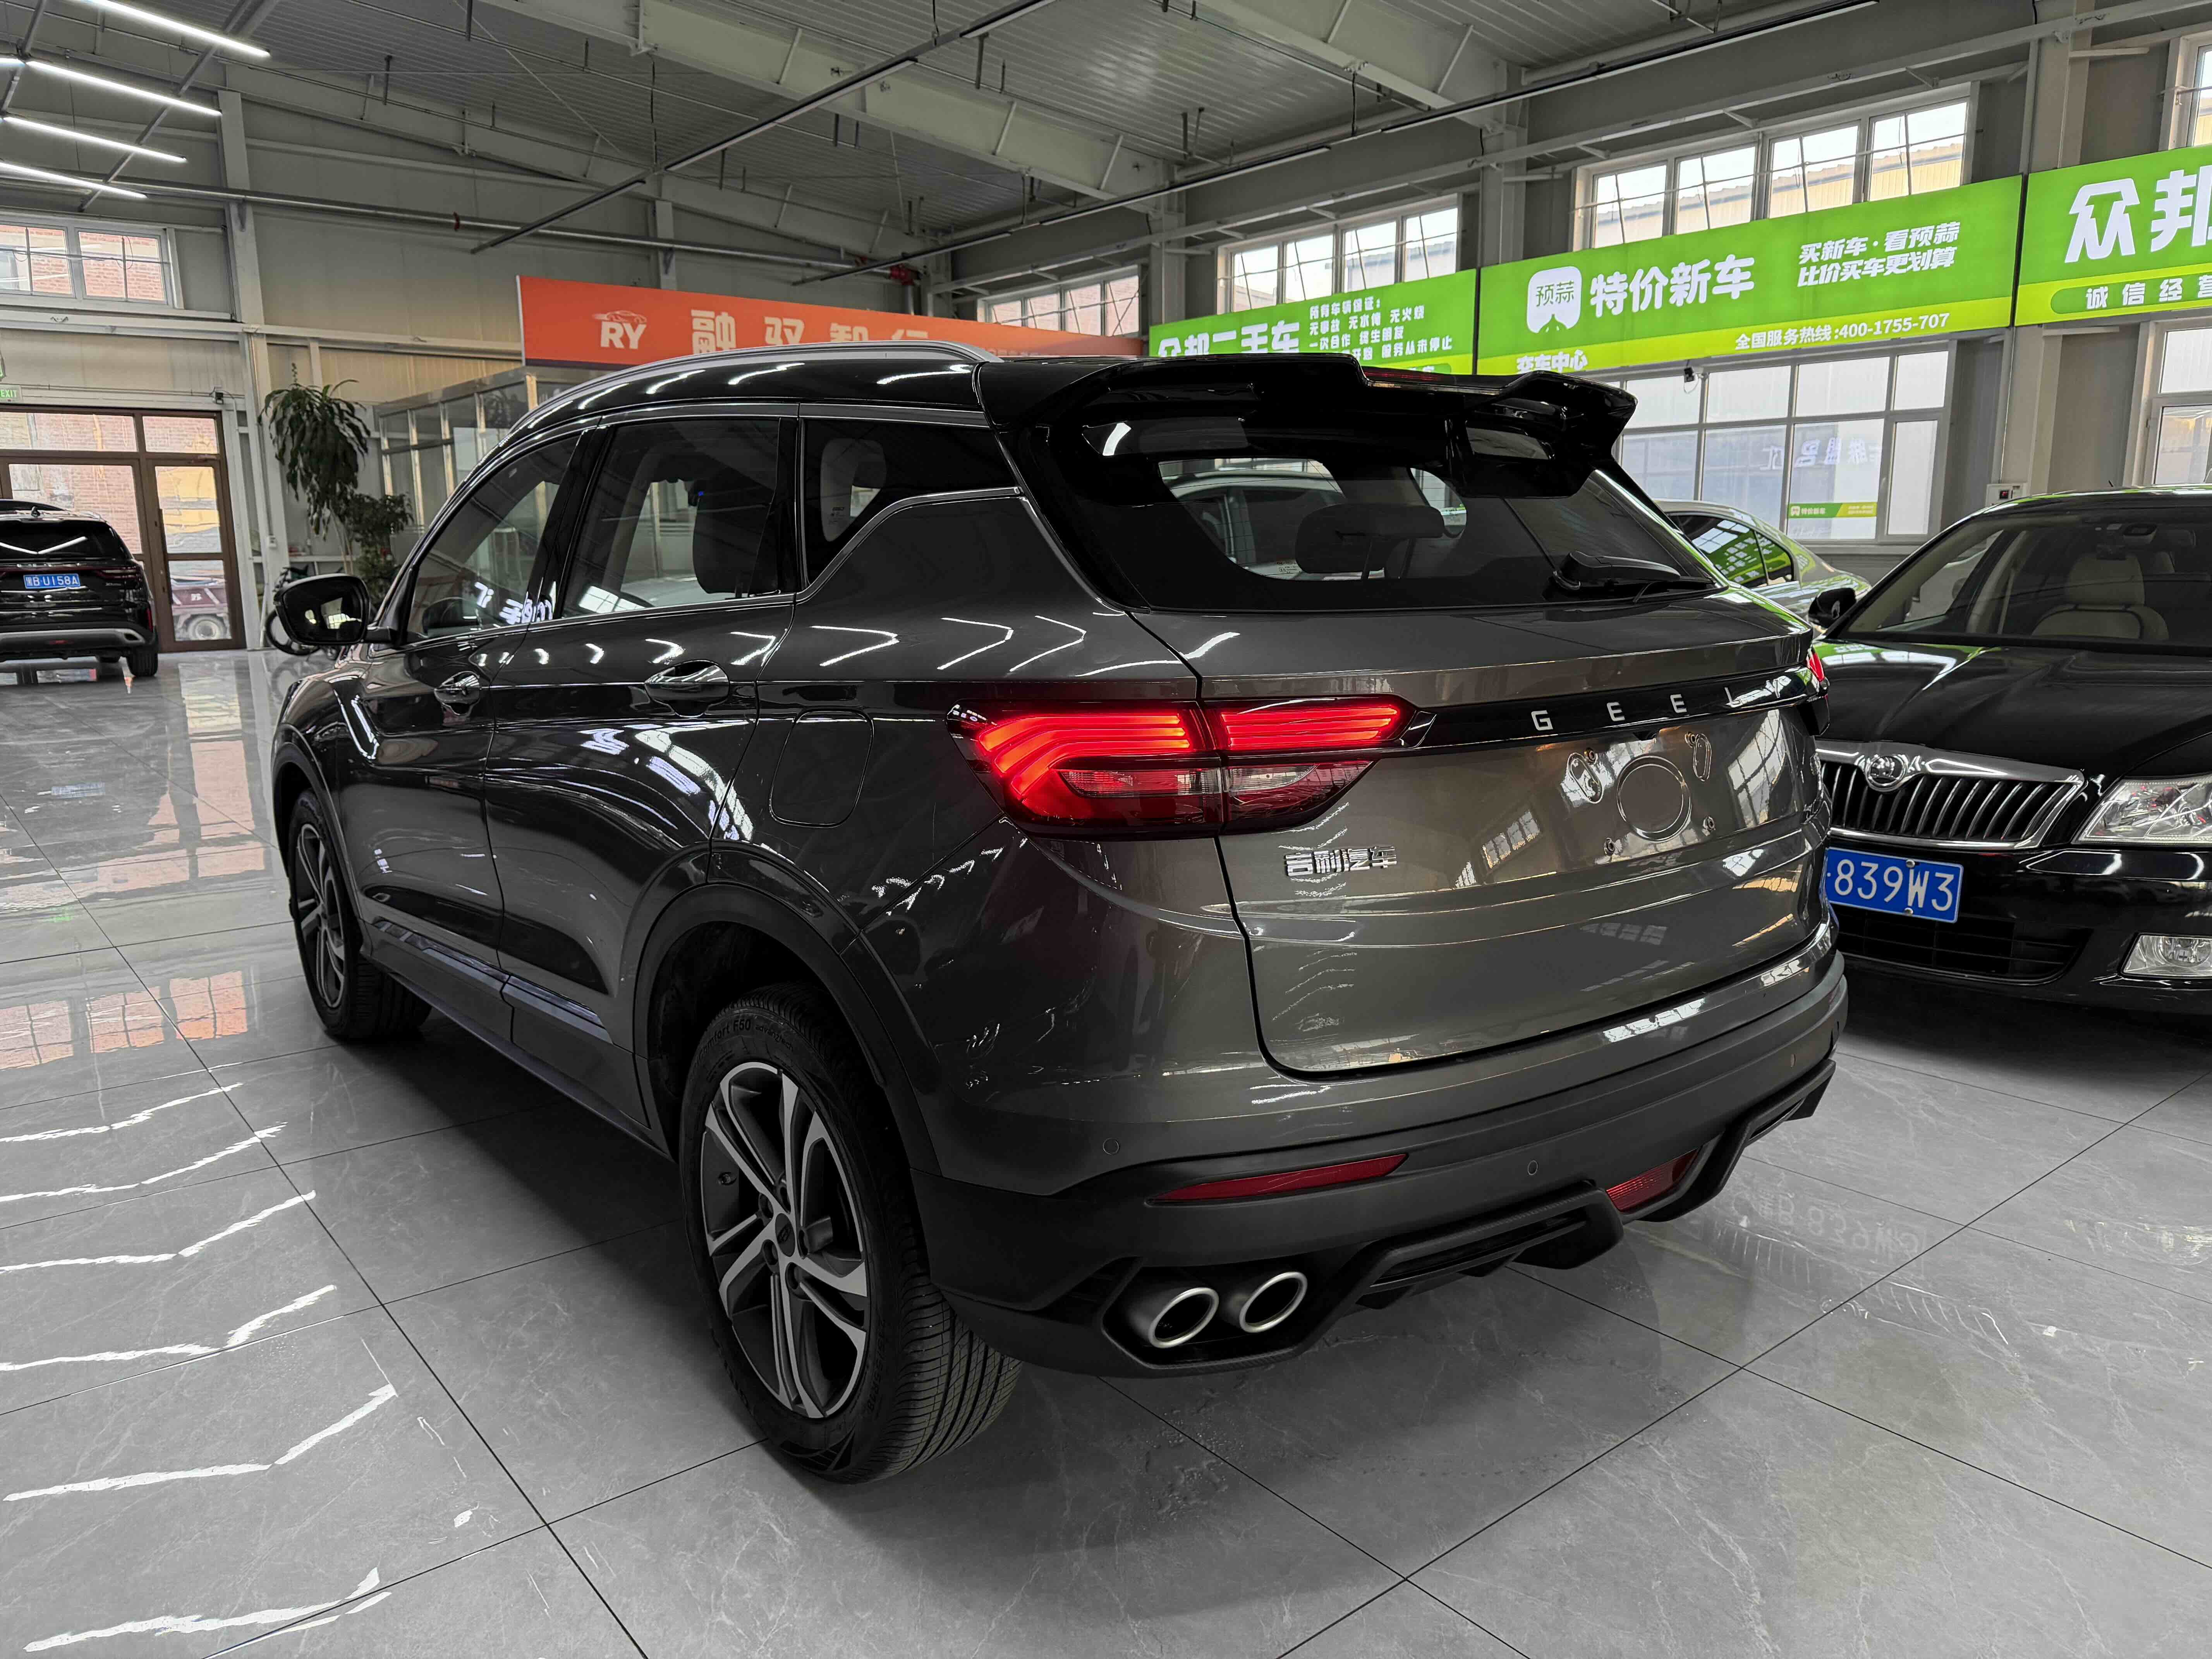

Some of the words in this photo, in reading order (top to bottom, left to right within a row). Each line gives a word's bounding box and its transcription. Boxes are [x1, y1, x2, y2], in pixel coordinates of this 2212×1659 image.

[1797, 246, 1957, 287] 比价买车更划算
[1536, 280, 1574, 307] 预蒜
[1590, 254, 1755, 318] 特价新车
[601, 322, 646, 349] RY
[1381, 335, 1453, 358] 服务从未停止
[1285, 846, 1397, 876] 吉利汽车
